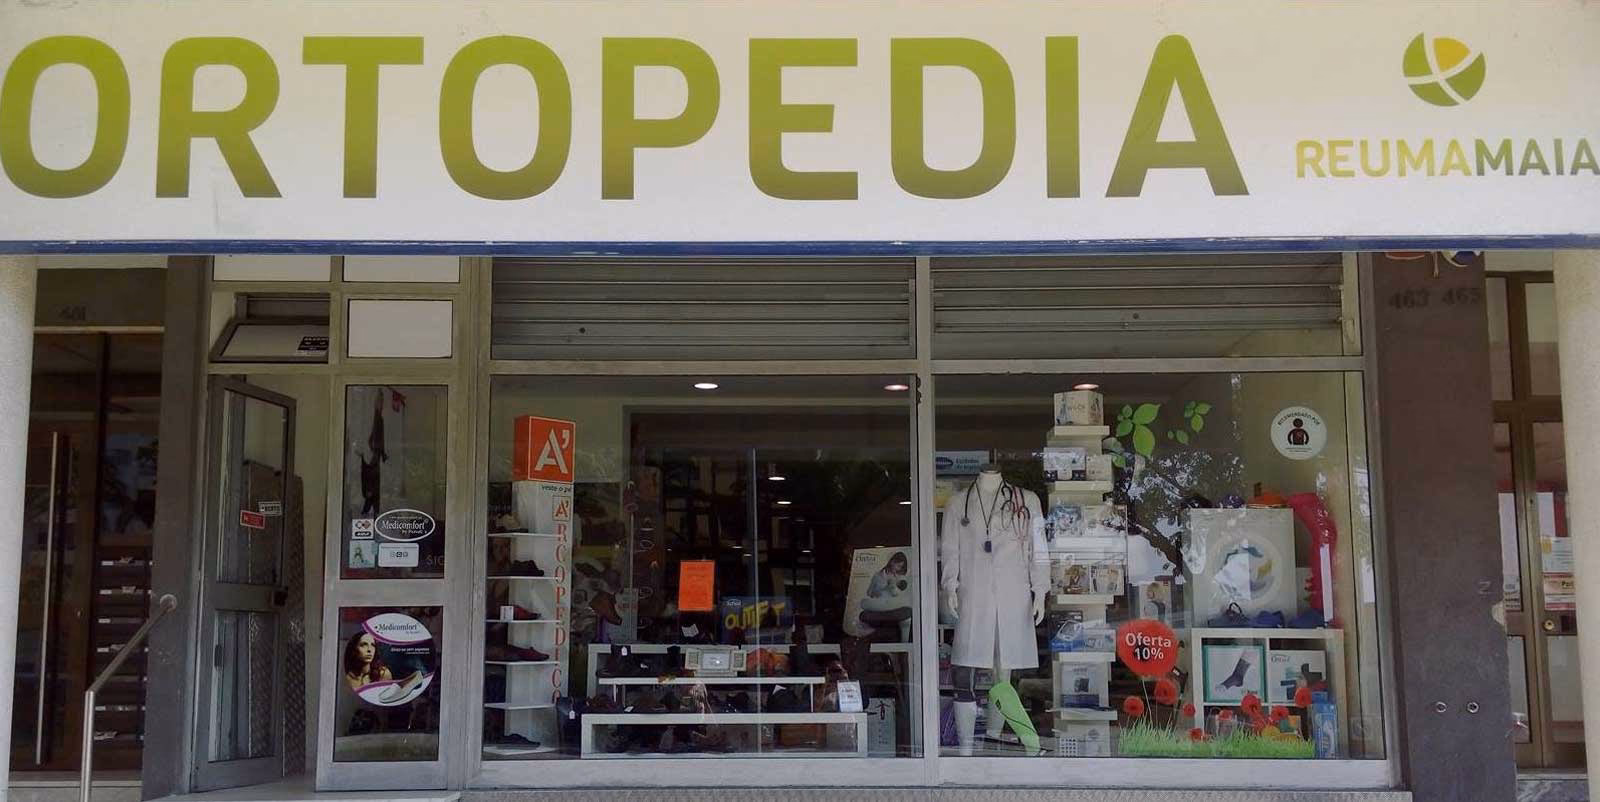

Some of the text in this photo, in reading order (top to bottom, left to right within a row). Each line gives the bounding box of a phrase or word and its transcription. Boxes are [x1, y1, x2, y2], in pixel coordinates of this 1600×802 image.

[0, 34, 1248, 200] ORTOPEDIA
[1295, 137, 1600, 178] REUMAMAIA
[1125, 632, 1172, 648] Oferta
[1134, 647, 1165, 661] 10%
